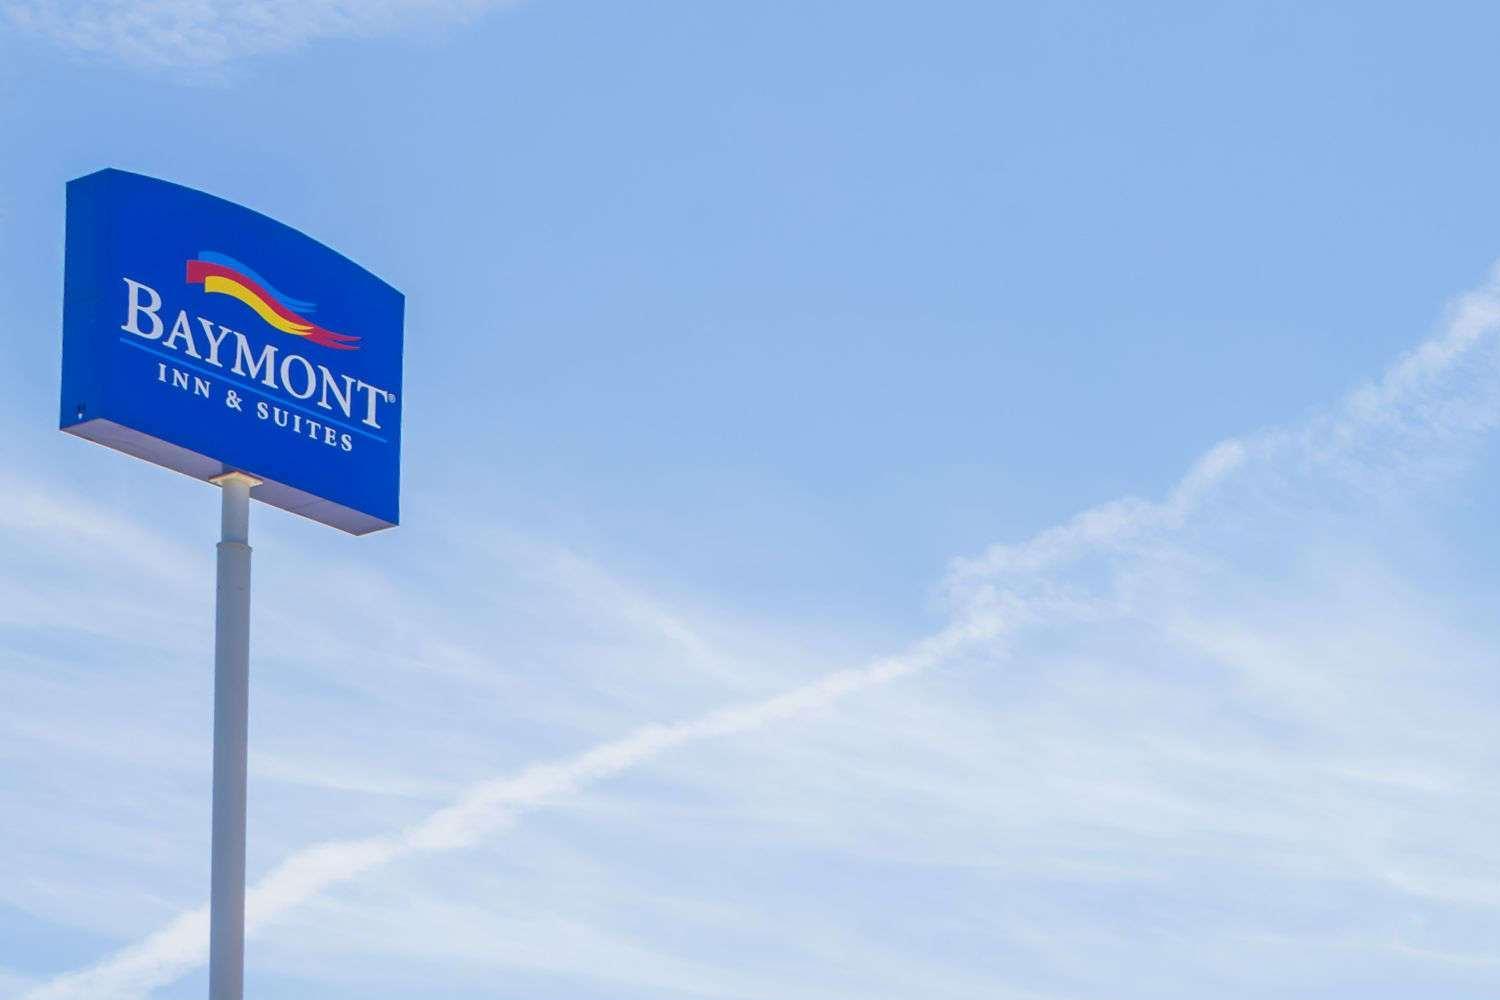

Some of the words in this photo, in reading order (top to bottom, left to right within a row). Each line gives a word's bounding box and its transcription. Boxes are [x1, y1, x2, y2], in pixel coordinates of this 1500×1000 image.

[121, 277, 388, 429] BAYMONT
[157, 363, 212, 399] INN
[225, 390, 243, 412] &
[256, 402, 353, 452] SUITES
